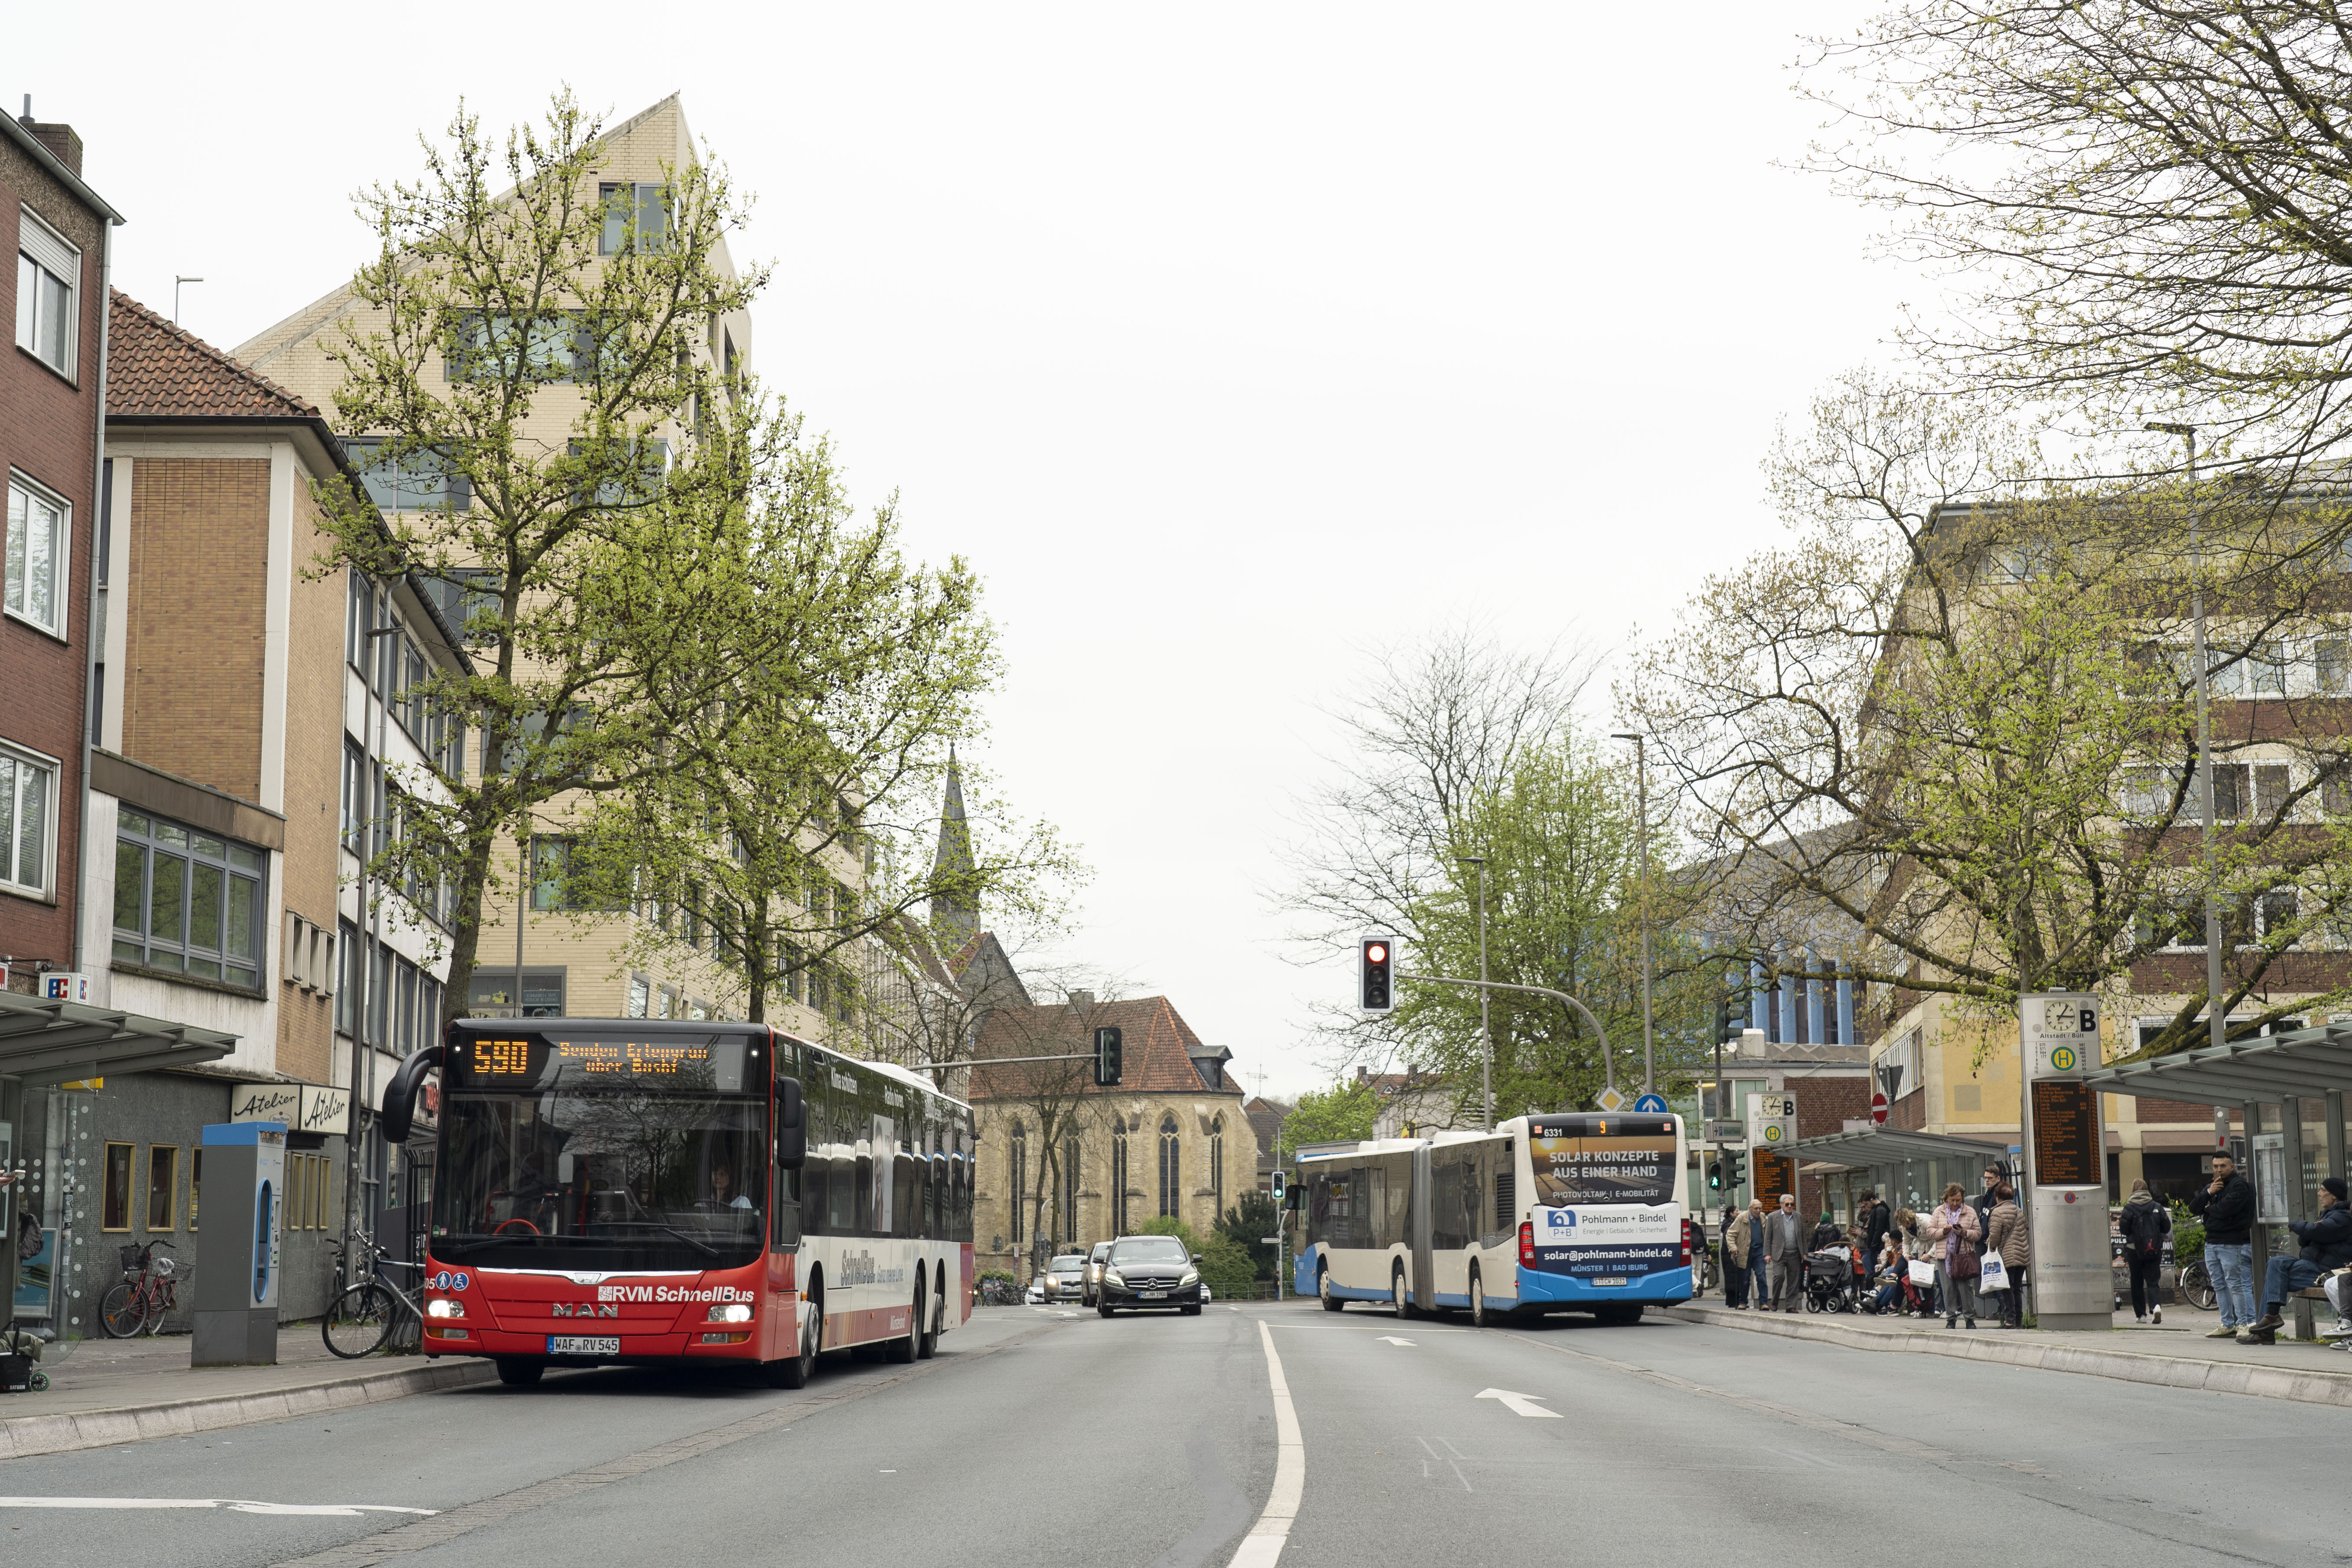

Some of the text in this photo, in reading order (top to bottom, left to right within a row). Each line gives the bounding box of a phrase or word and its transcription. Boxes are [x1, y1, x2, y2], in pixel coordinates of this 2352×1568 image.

[2079, 1010, 2096, 1032] B
[2058, 1052, 2069, 1066] H
[831, 1066, 841, 1090] Klima
[884, 1085, 894, 1106] Radio
[234, 1092, 296, 1116] Atelier
[304, 1090, 345, 1129] Atelier
[1783, 1101, 1794, 1116] B
[1544, 1128, 1562, 1137] 6331
[1599, 1120, 1606, 1133] 9
[1769, 1129, 1776, 1138] H
[1549, 1150, 1659, 1162] SOLAR KONZEPTE
[1553, 1166, 1657, 1178] AUS EINER HAND
[1553, 1190, 1606, 1198] PHOTOVOLTAIK
[1616, 1188, 1659, 1197] E-MOBILITÄT
[1582, 1214, 1628, 1224] Pohlmann
[1639, 1213, 1667, 1222] Bindel
[1553, 1228, 1572, 1237] P+B
[1544, 1248, 1673, 1262] solar@pohlmann-bindel.de
[425, 1278, 436, 1290] 05
[612, 1286, 755, 1302] RVM SchnellBus
[552, 1303, 618, 1318] MAN
[555, 1338, 618, 1351] WAF RV 545
